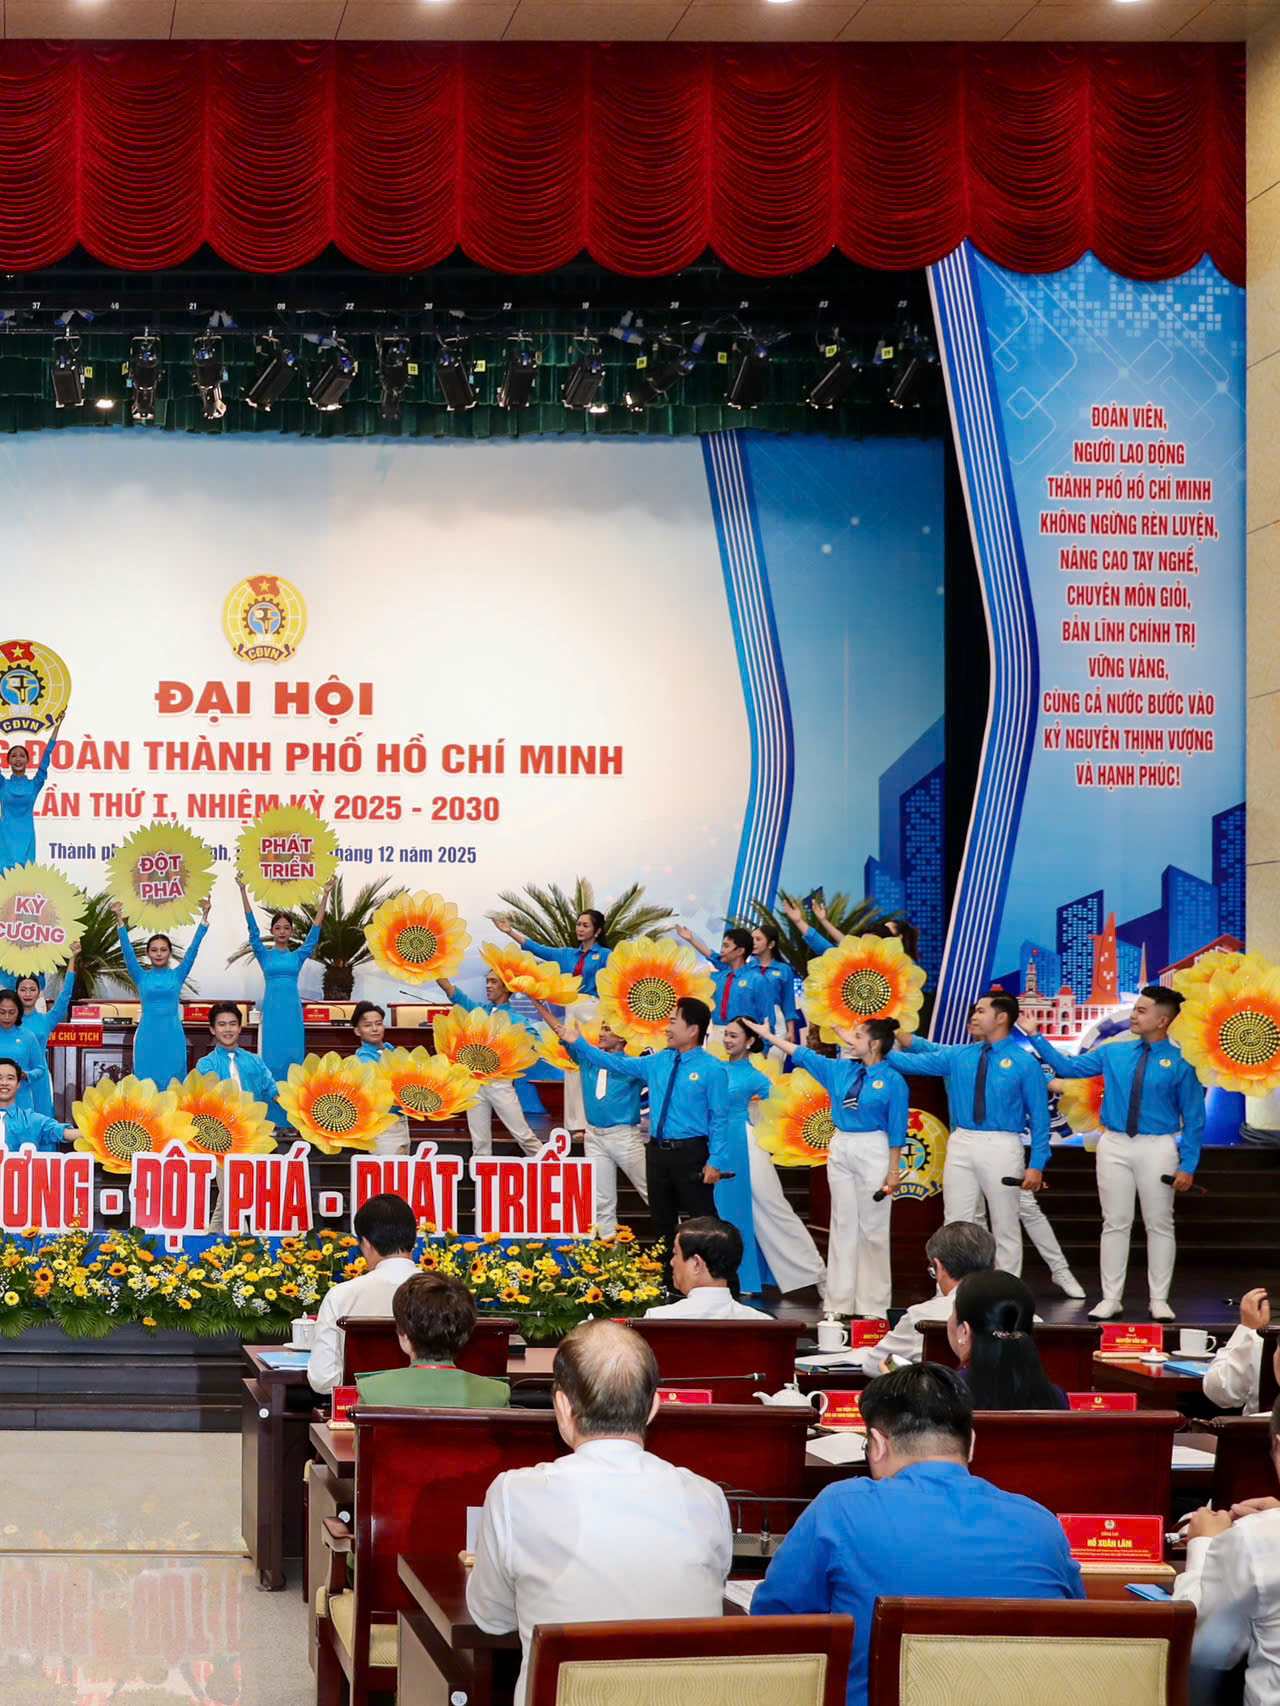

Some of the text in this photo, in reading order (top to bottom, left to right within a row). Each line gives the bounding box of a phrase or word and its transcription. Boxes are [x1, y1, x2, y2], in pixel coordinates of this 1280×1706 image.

[1092, 404, 1168, 429] ĐOÀN VIÊN,
[1074, 440, 1185, 468] NGƯỜI LAO ĐỘNG
[1048, 474, 1212, 501] THÀNH PHỐ HỒ CHÍ MINH
[1041, 510, 1219, 541] KHÔNG NGỪNG RÈN LUYỆN,
[1061, 547, 1199, 574] NÂNG CAO TAY NGHỀ,
[1068, 582, 1192, 608] CHUYÊN MÔN GIỎI,
[1064, 616, 1196, 648] BẢN LĨNH CHÍNH TRỊ
[1090, 654, 1170, 680] VỮNG VÀNG,
[156, 675, 372, 724] ĐẠI HỘI
[1044, 688, 1216, 716] CÙNG CẢ NƯỚC BƯỚC VÀO
[2, 718, 41, 733] CĐVN
[1045, 723, 1214, 754] KỶ NGUYÊN THỊNH VƯỢNG
[25, 734, 130, 771] ĐOÀN
[144, 736, 271, 771] THÀNH
[287, 733, 362, 772] PHỐ
[378, 735, 426, 773] HỒ
[443, 739, 504, 774] CHÍ
[521, 746, 623, 775] MINH
[1077, 765, 1180, 790] VÀ HẠNH PHÚC!
[32, 784, 80, 817] ẦN
[91, 788, 145, 818] THỨ
[154, 794, 176, 820] I,
[187, 788, 280, 824] NHIỆM
[336, 796, 402, 820] 2025
[432, 797, 499, 821] 2030
[49, 843, 96, 859] Thành
[330, 845, 373, 864] háng
[379, 846, 395, 862] 12
[400, 847, 433, 863] năm
[438, 847, 477, 864] 2025
[261, 835, 313, 854] PHÁT
[139, 851, 181, 874] ĐỘT
[261, 858, 314, 878] TRIỂN
[141, 878, 184, 899] PHÁ
[15, 894, 45, 915] KỶ
[136, 1145, 211, 1246] ĐỘT
[230, 1149, 308, 1231] PHÁ
[358, 1147, 458, 1231] PHÁT
[477, 1136, 591, 1233] TRIỂN
